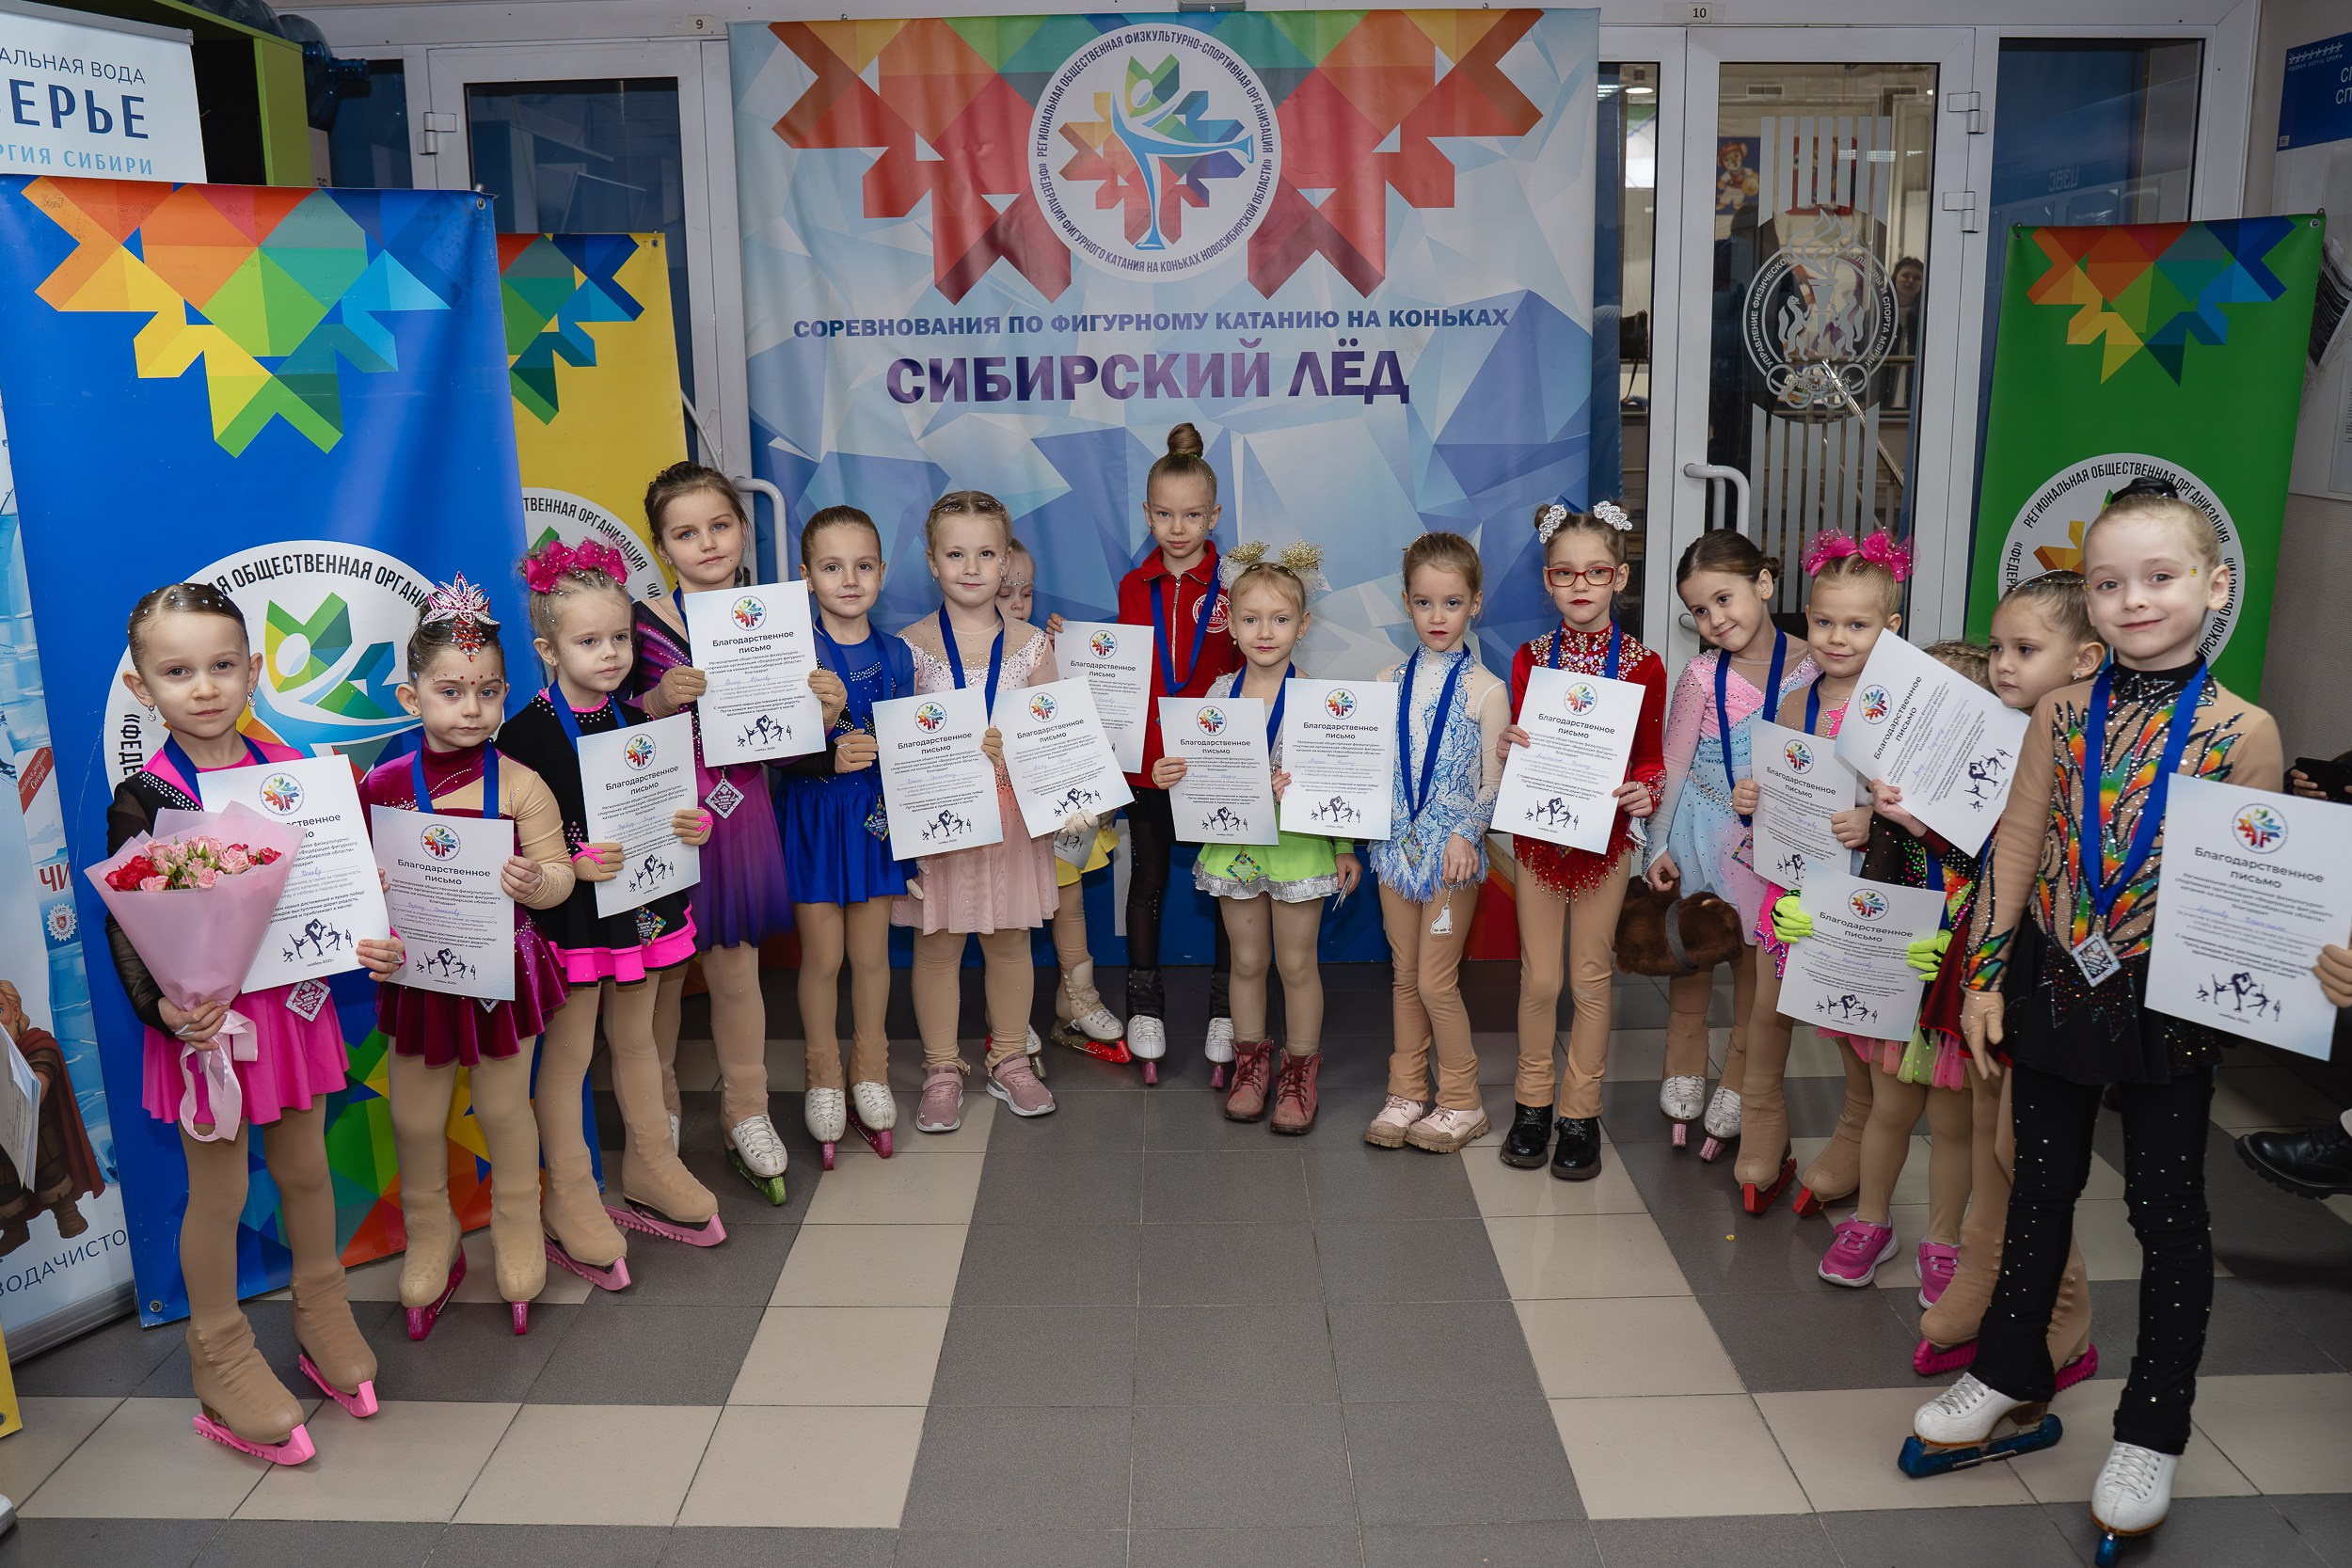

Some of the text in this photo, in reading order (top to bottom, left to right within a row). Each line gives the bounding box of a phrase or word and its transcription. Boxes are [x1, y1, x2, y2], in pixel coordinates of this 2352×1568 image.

[696, 19, 704, 29] 9
[1692, 8, 1707, 18] 10
[90, 61, 146, 85] ВОДА
[1037, 30, 1274, 157] РЕГИОНАЛЬНАЯ ОБЩЕСТВЕННАЯ ФИЗКУЛЬТУРНО-СПОРТИВНАЯ ОРГАНИЗАЦИЯ
[0, 78, 149, 139] ЕРЬЕ
[63, 150, 152, 176] СИБИРИ
[1038, 158, 1272, 273] «ФЕДЕРАЦИЯ ФИГУРНОГО КАТАНИЯ НА КОНЬКАХ НОВОСИБИРСКОЙ ОБЛАСТИ»
[1846, 251, 1883, 287] КУЛЬУРЫ
[793, 308, 1509, 339] СОРЕВНОВАНИЯ ПО ФИГУРНОМУ КАТАНИЮ НА КОНЬКАХ
[1883, 295, 1891, 332] СПОРТА
[1750, 309, 1773, 369] УПРАВЛЕНИЕ
[1865, 335, 1887, 367] МЭРИИ
[886, 337, 1410, 405] СИБИРСКИЙ ЛЁД
[1784, 375, 1851, 391] НОВОСИБИСК
[2023, 461, 2231, 544] РЕГИОНАЛЬНАЯ ОБЩЕСТВЕННАЯ ОРГАНИЗАЦИЯ
[523, 497, 648, 572] ТВЕННАЯ ОРГАНИЗАЦИЯ
[231, 553, 373, 589] ОБЩЕСТВЕННАЯ
[712, 631, 794, 647] Благодарственное
[739, 644, 771, 654] письмо
[1070, 660, 1136, 672] Благодарственное
[1016, 718, 1085, 739] Благодарственное
[1303, 721, 1378, 732] Благодарственное
[1537, 713, 1615, 735] Благодарственное
[1873, 675, 1922, 760] Благодарственное
[1895, 706, 1917, 742] письмо
[898, 732, 972, 750] Благодарственное
[1039, 731, 1067, 743] письмо
[1180, 738, 1251, 748] Благодарственное
[1557, 727, 1590, 739] письмо
[921, 744, 951, 754] письмо
[605, 765, 679, 791] Благодарственное
[630, 782, 660, 796] письмо
[1766, 766, 1836, 795] Благодарственное
[1785, 783, 1813, 799] письмо
[397, 859, 491, 878] Благодарственное
[2194, 846, 2325, 884] Благодарственное
[424, 874, 462, 885] письмо
[2230, 869, 2282, 889] письмо
[1820, 911, 1914, 938] Благодарственное
[1844, 928, 1883, 942] письмо
